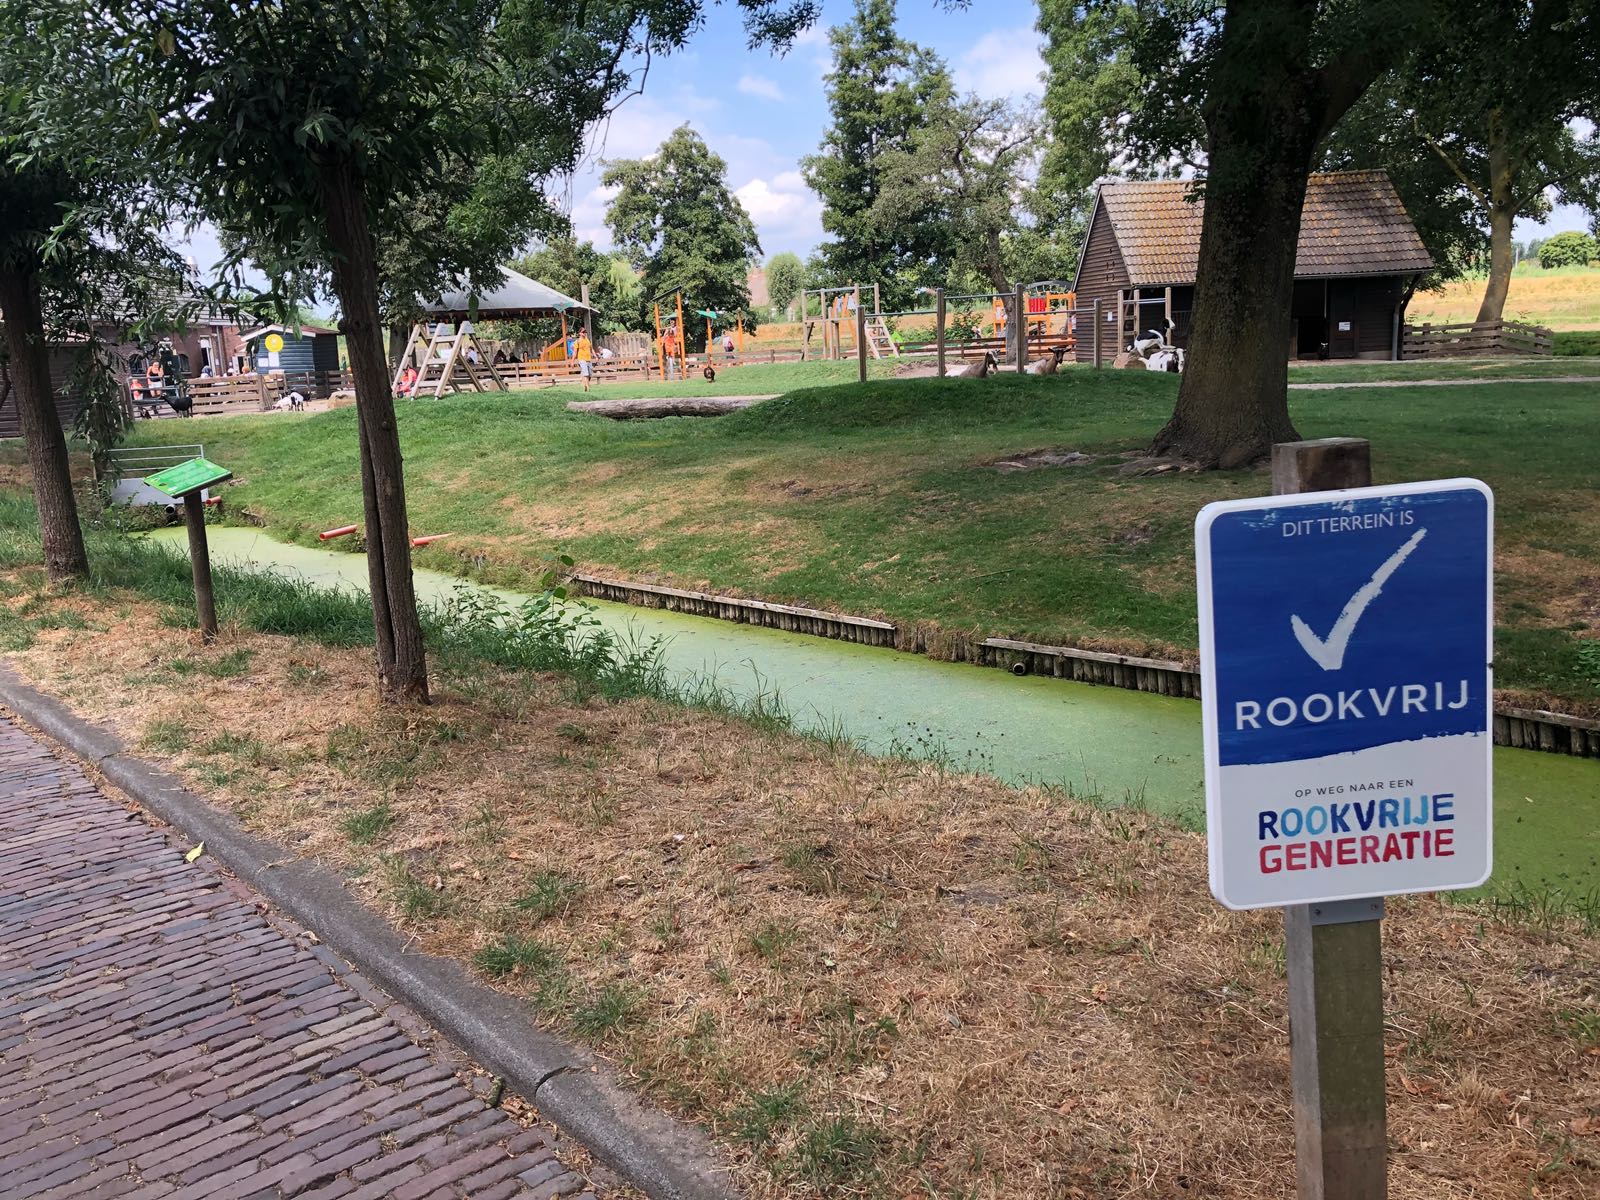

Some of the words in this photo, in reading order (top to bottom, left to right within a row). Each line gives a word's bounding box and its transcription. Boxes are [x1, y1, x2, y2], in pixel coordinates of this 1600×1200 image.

[1282, 519, 1313, 537] DIT
[1317, 512, 1394, 534] TERREIN
[1400, 510, 1414, 526] IS
[1235, 680, 1469, 730] ROOKVRIJ
[1295, 788, 1312, 798] OP
[1316, 785, 1344, 796] WEG
[1350, 781, 1384, 793] NAAR
[1389, 779, 1414, 789] EEN
[1258, 793, 1454, 840] ROOKVRIJE
[1259, 828, 1455, 874] GENERATIE
